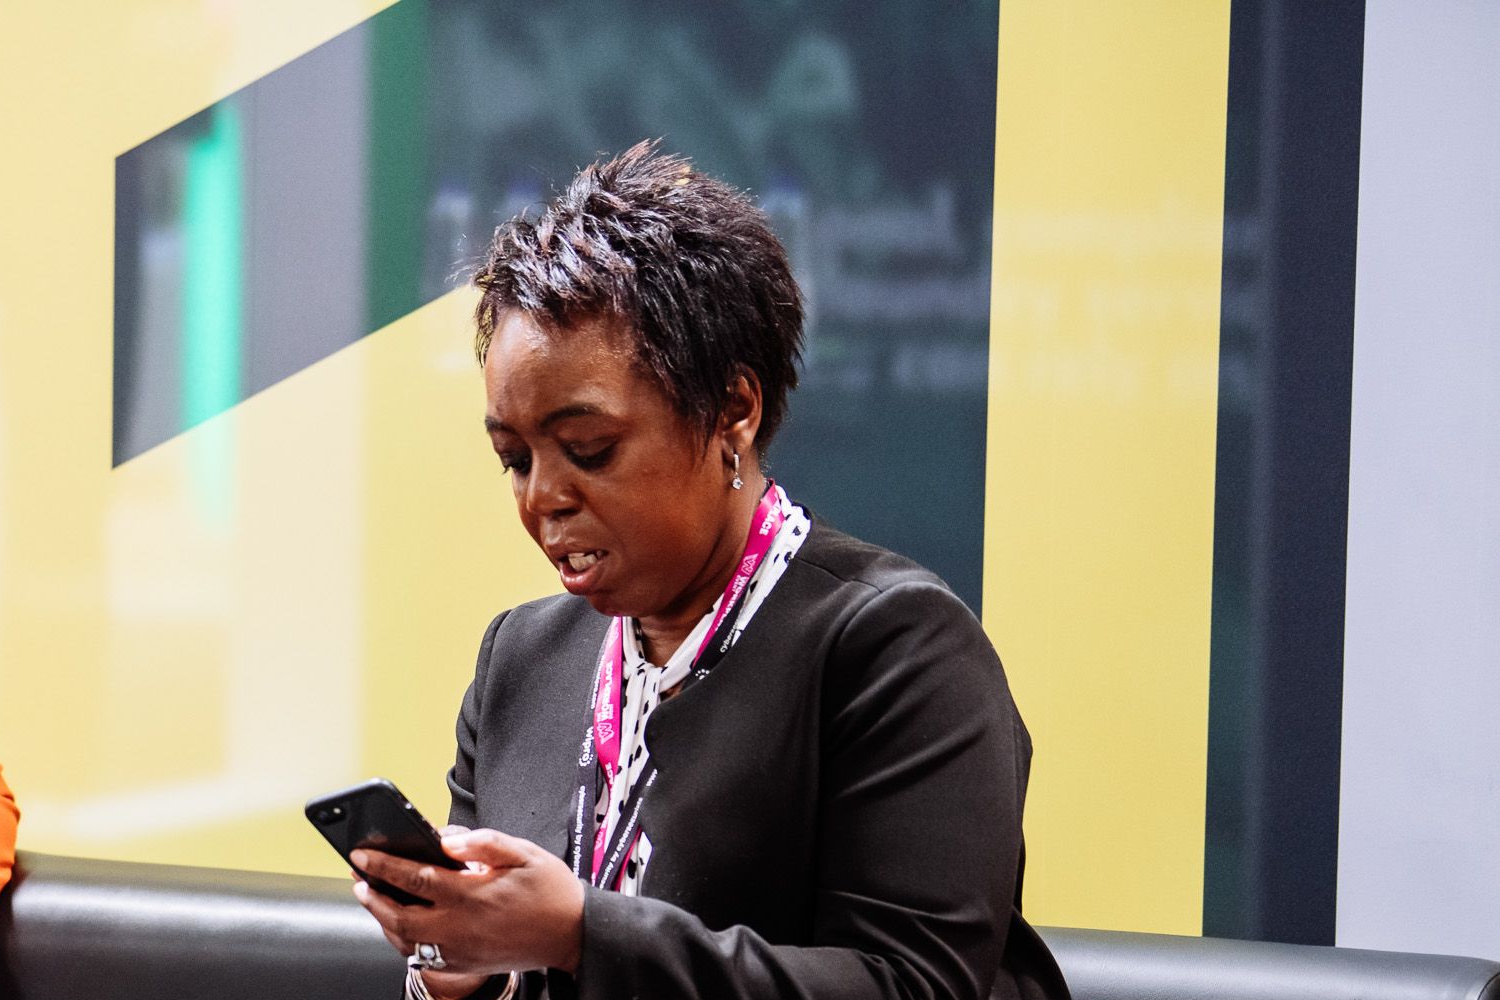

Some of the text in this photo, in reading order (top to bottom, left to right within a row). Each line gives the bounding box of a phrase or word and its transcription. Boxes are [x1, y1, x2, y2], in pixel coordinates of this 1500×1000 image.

[580, 726, 595, 764] wipro
[574, 834, 583, 846] by
[610, 850, 620, 863] by
